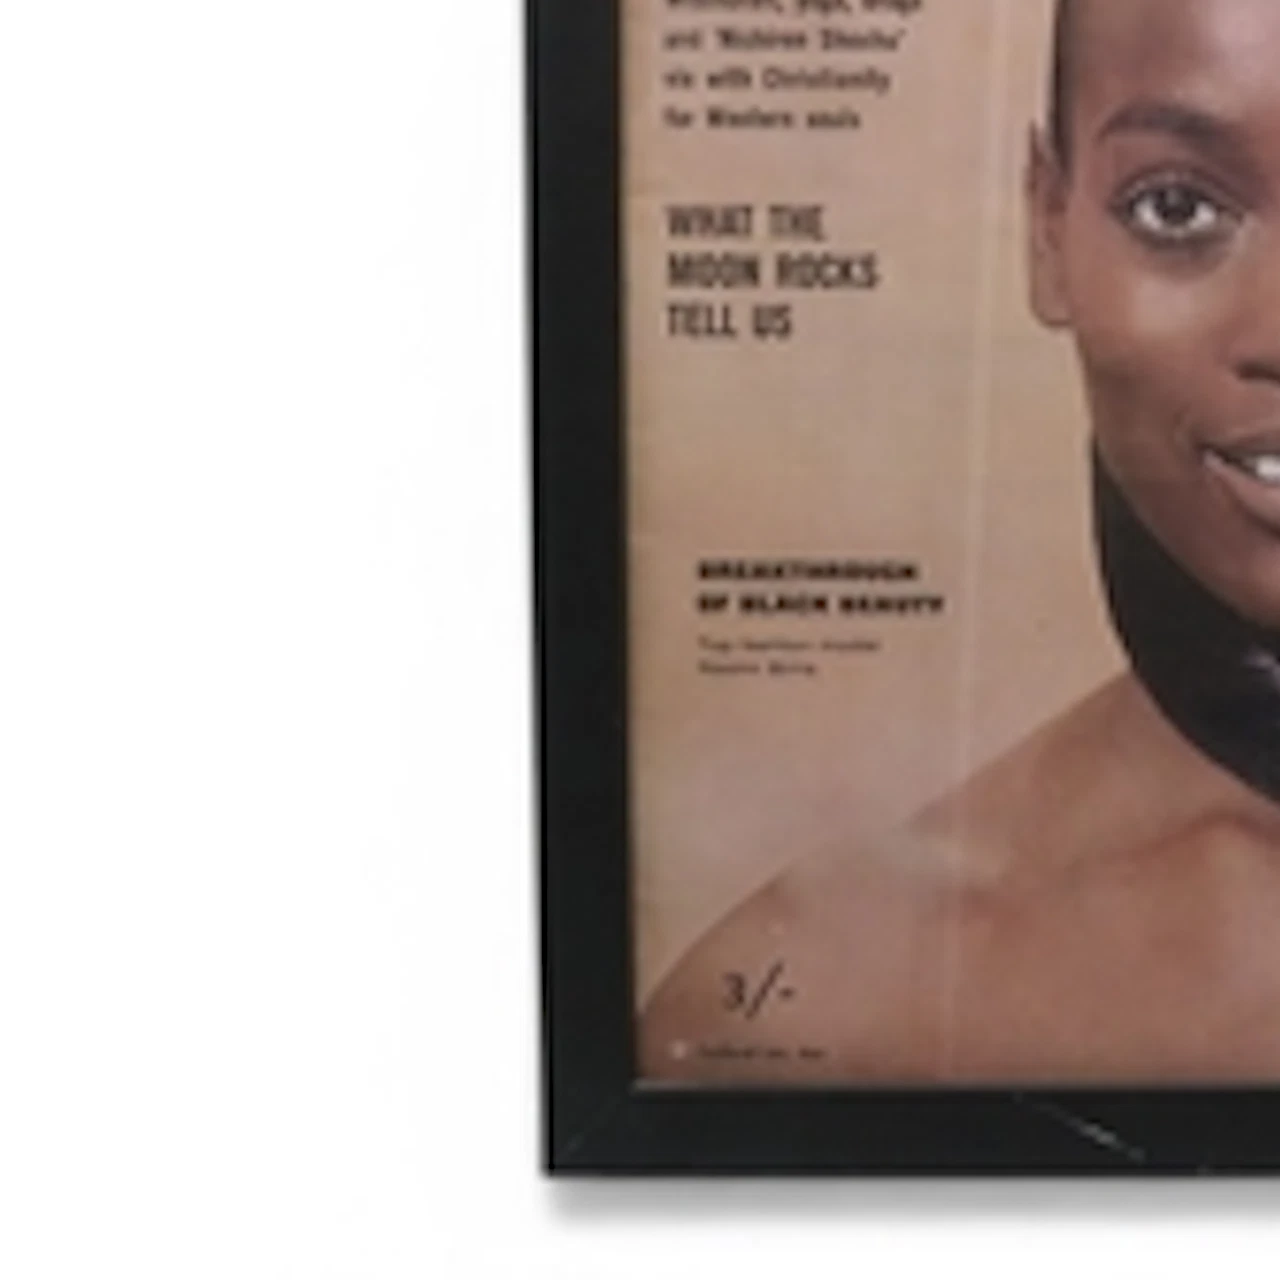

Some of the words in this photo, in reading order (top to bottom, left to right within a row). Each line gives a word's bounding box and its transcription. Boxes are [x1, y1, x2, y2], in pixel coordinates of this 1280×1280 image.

[761, 66, 893, 96] Christianity
[665, 204, 754, 239] WHAT
[768, 204, 825, 241] THE
[667, 251, 761, 290] MOON
[774, 251, 880, 291] ROCKS
[666, 301, 738, 339] TELL
[753, 303, 793, 340] US
